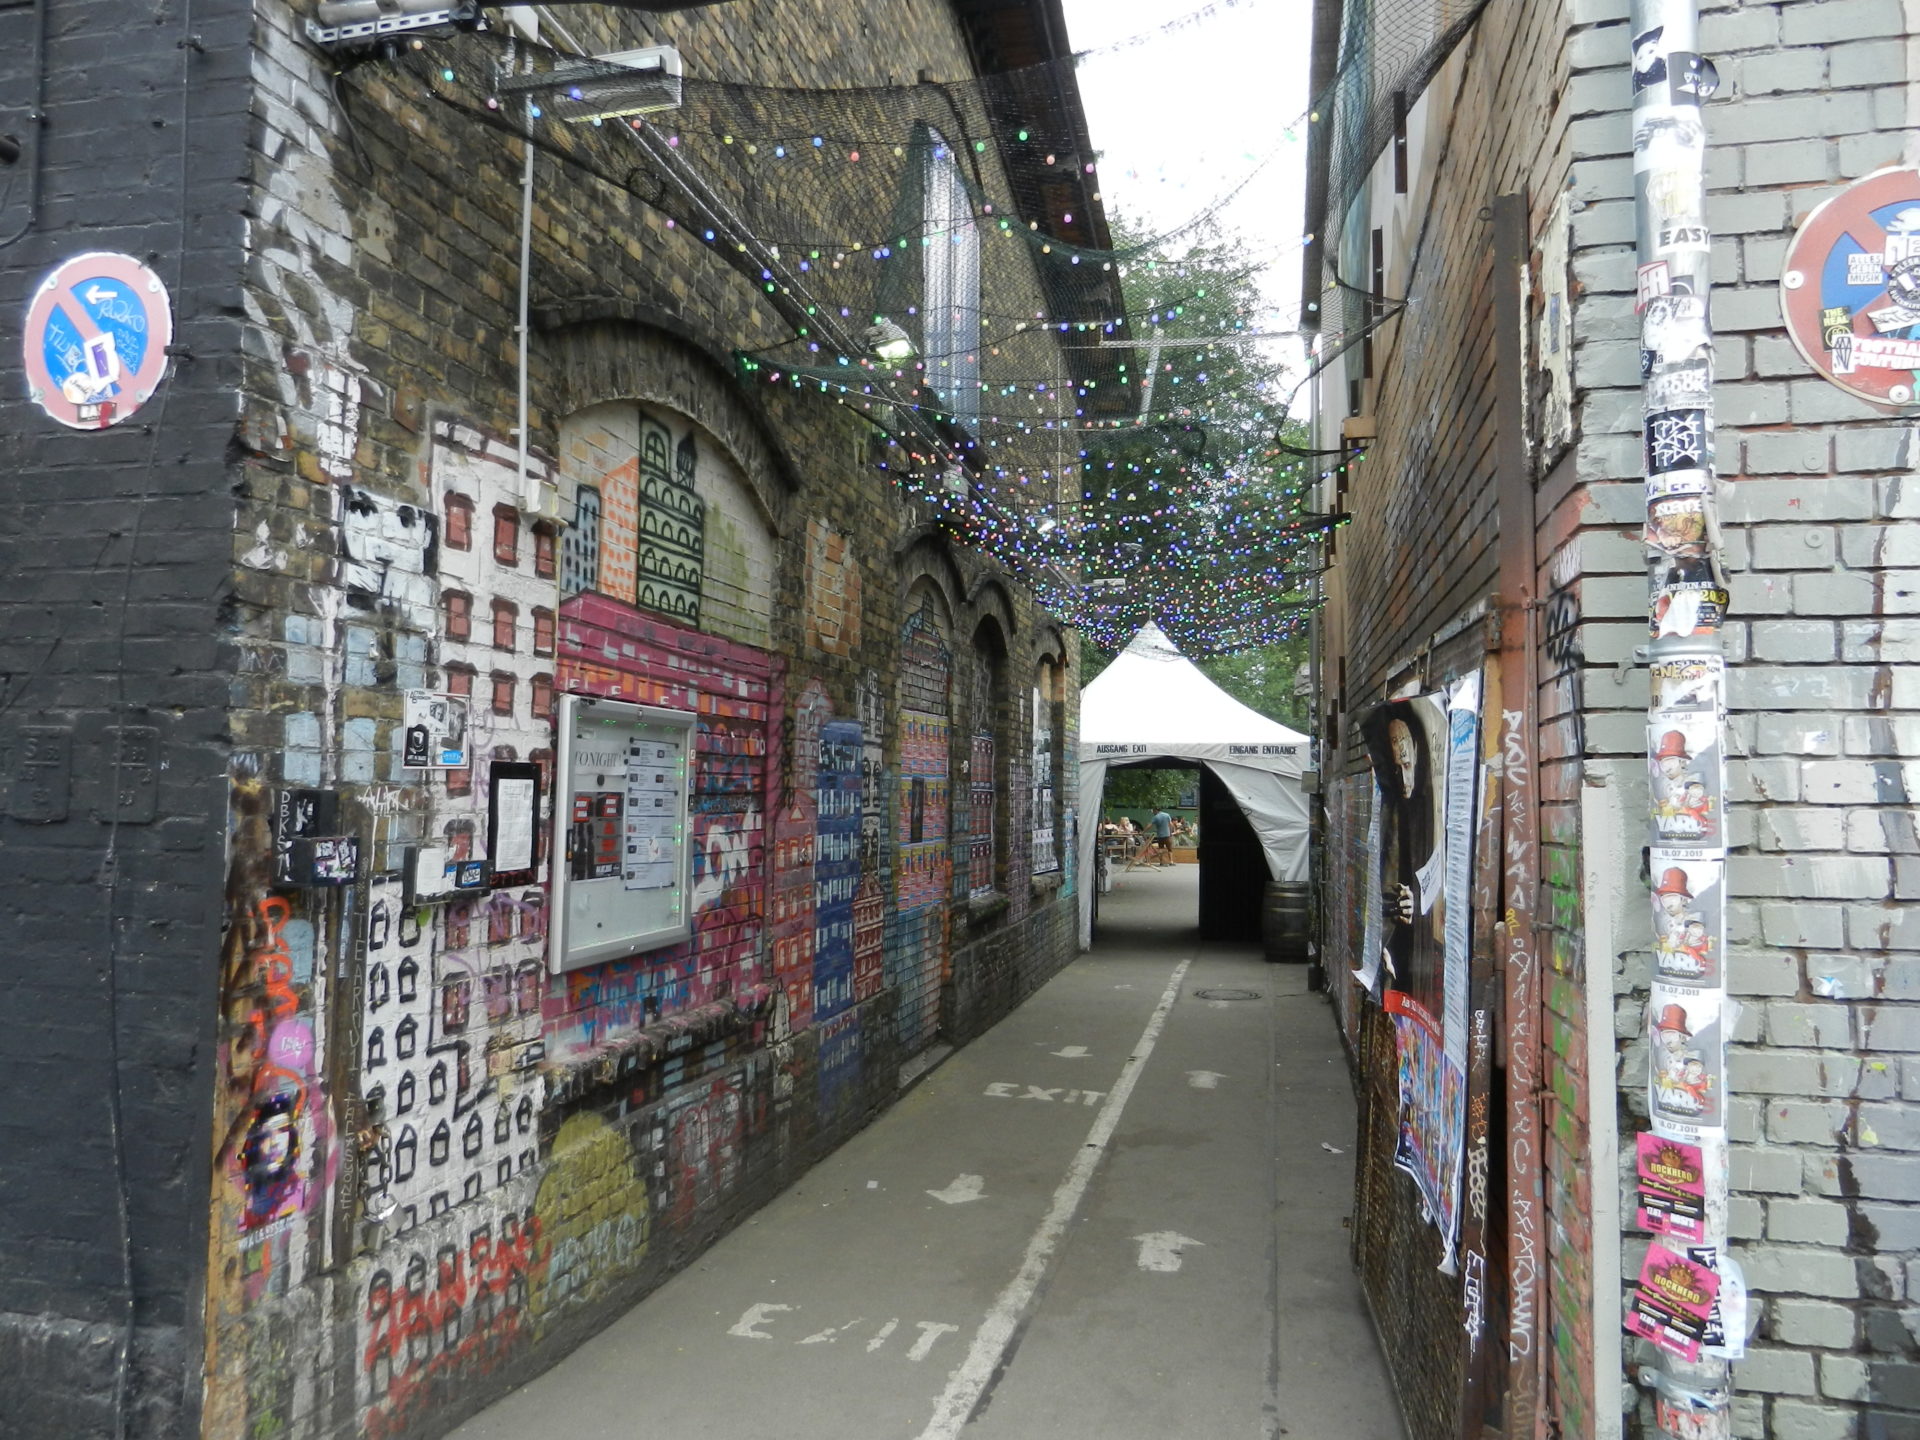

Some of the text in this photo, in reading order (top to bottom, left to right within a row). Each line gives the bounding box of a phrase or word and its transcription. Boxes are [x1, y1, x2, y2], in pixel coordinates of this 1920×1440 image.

[1659, 228, 1710, 247] EASY
[1850, 273, 1881, 282] MUSIK
[1824, 307, 1844, 318] THE
[1096, 744, 1147, 753] AUSGANG EXIT
[1229, 745, 1298, 755] EINGANG ENTRANCE
[983, 1082, 1107, 1106] EXIT
[1650, 1163, 1693, 1183] ROCKHERO
[1654, 1275, 1700, 1304] ROCKHERO
[726, 1303, 960, 1362] EXIT
